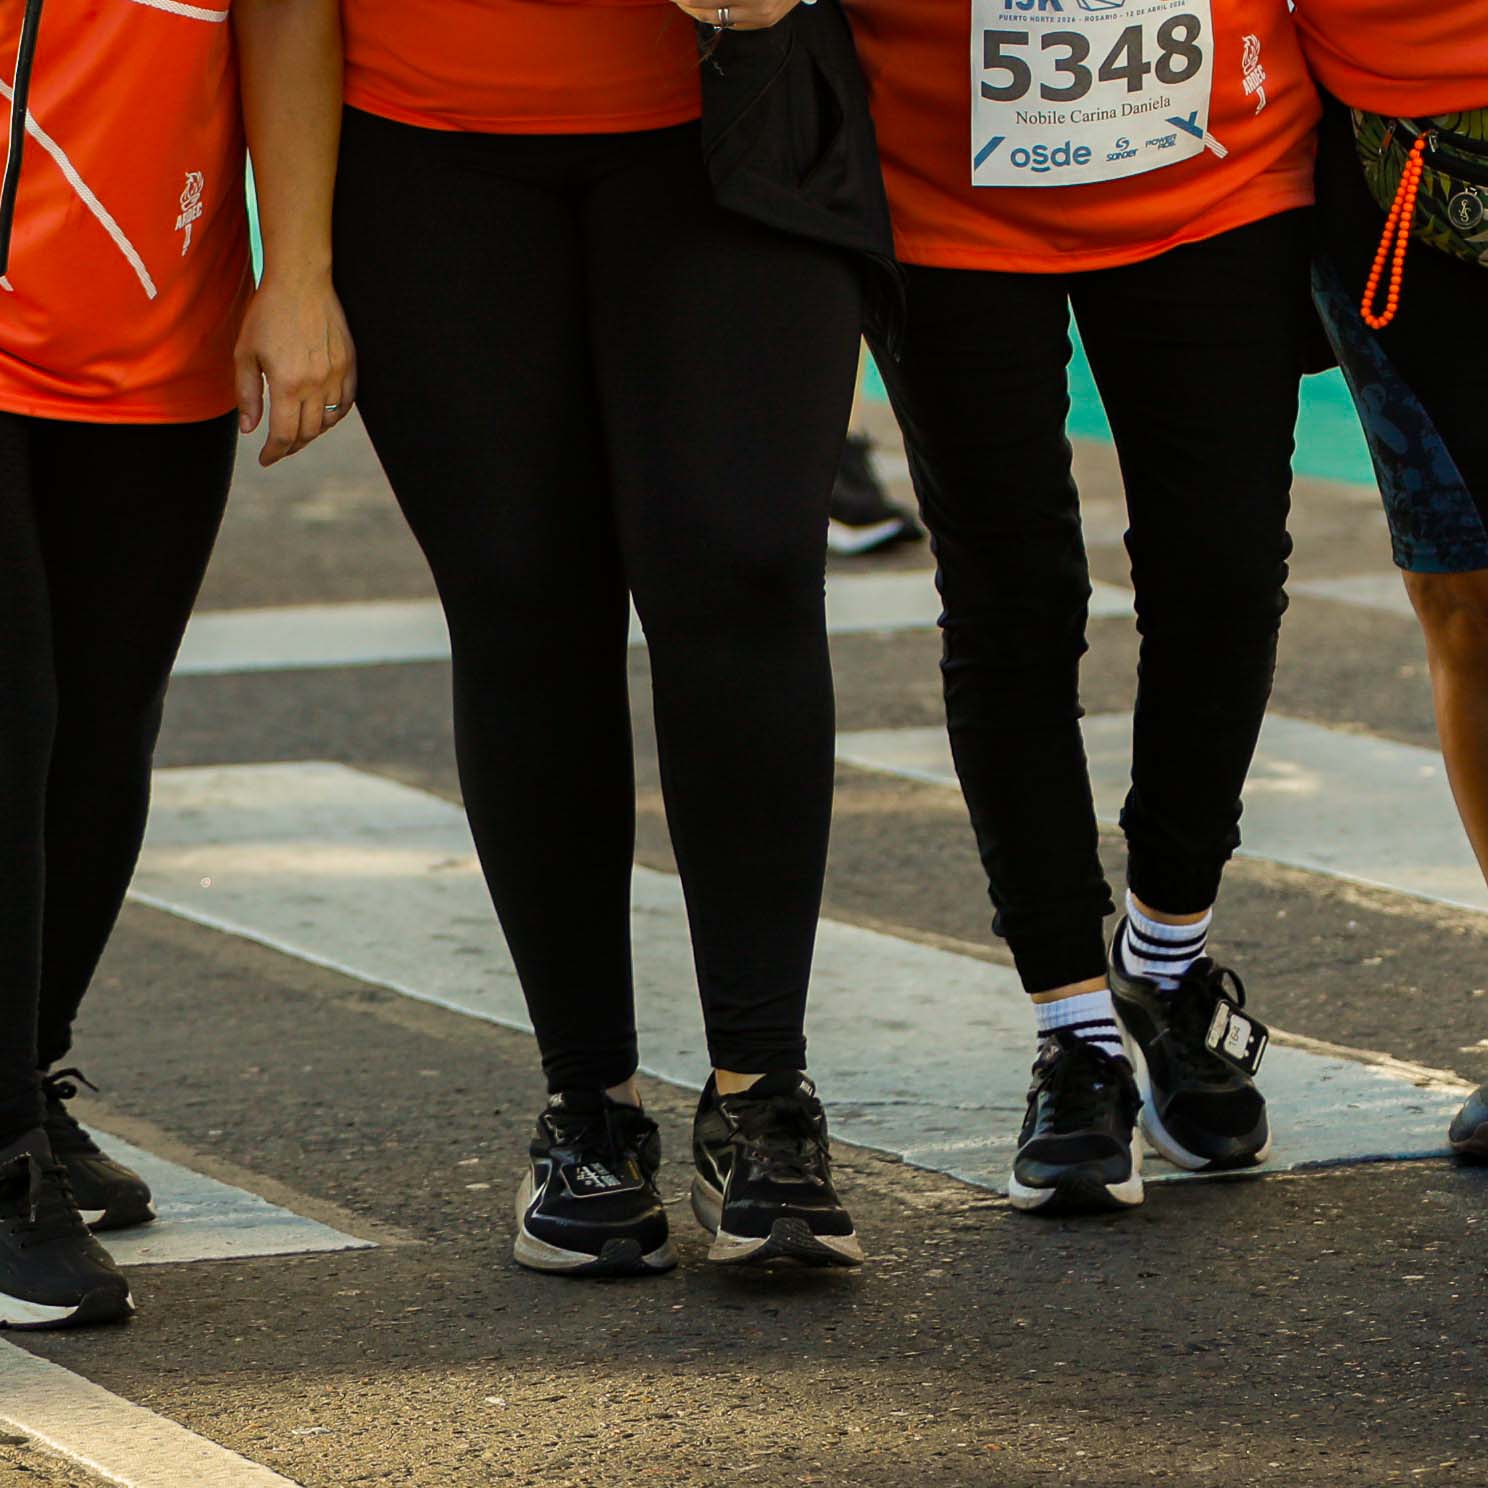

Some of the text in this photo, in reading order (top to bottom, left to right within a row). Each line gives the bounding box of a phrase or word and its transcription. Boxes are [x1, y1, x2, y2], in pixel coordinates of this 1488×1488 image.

[998, 14, 1028, 22] PUERTO
[1029, 15, 1055, 23] NORTE
[1084, 12, 1118, 22] ROSARIO
[1136, 8, 1146, 16] DE
[1147, 5, 1168, 14] ABRIL
[980, 13, 1203, 102] 5348
[1015, 95, 1171, 125] Nobile Carina Daniela
[1010, 140, 1092, 173] osde
